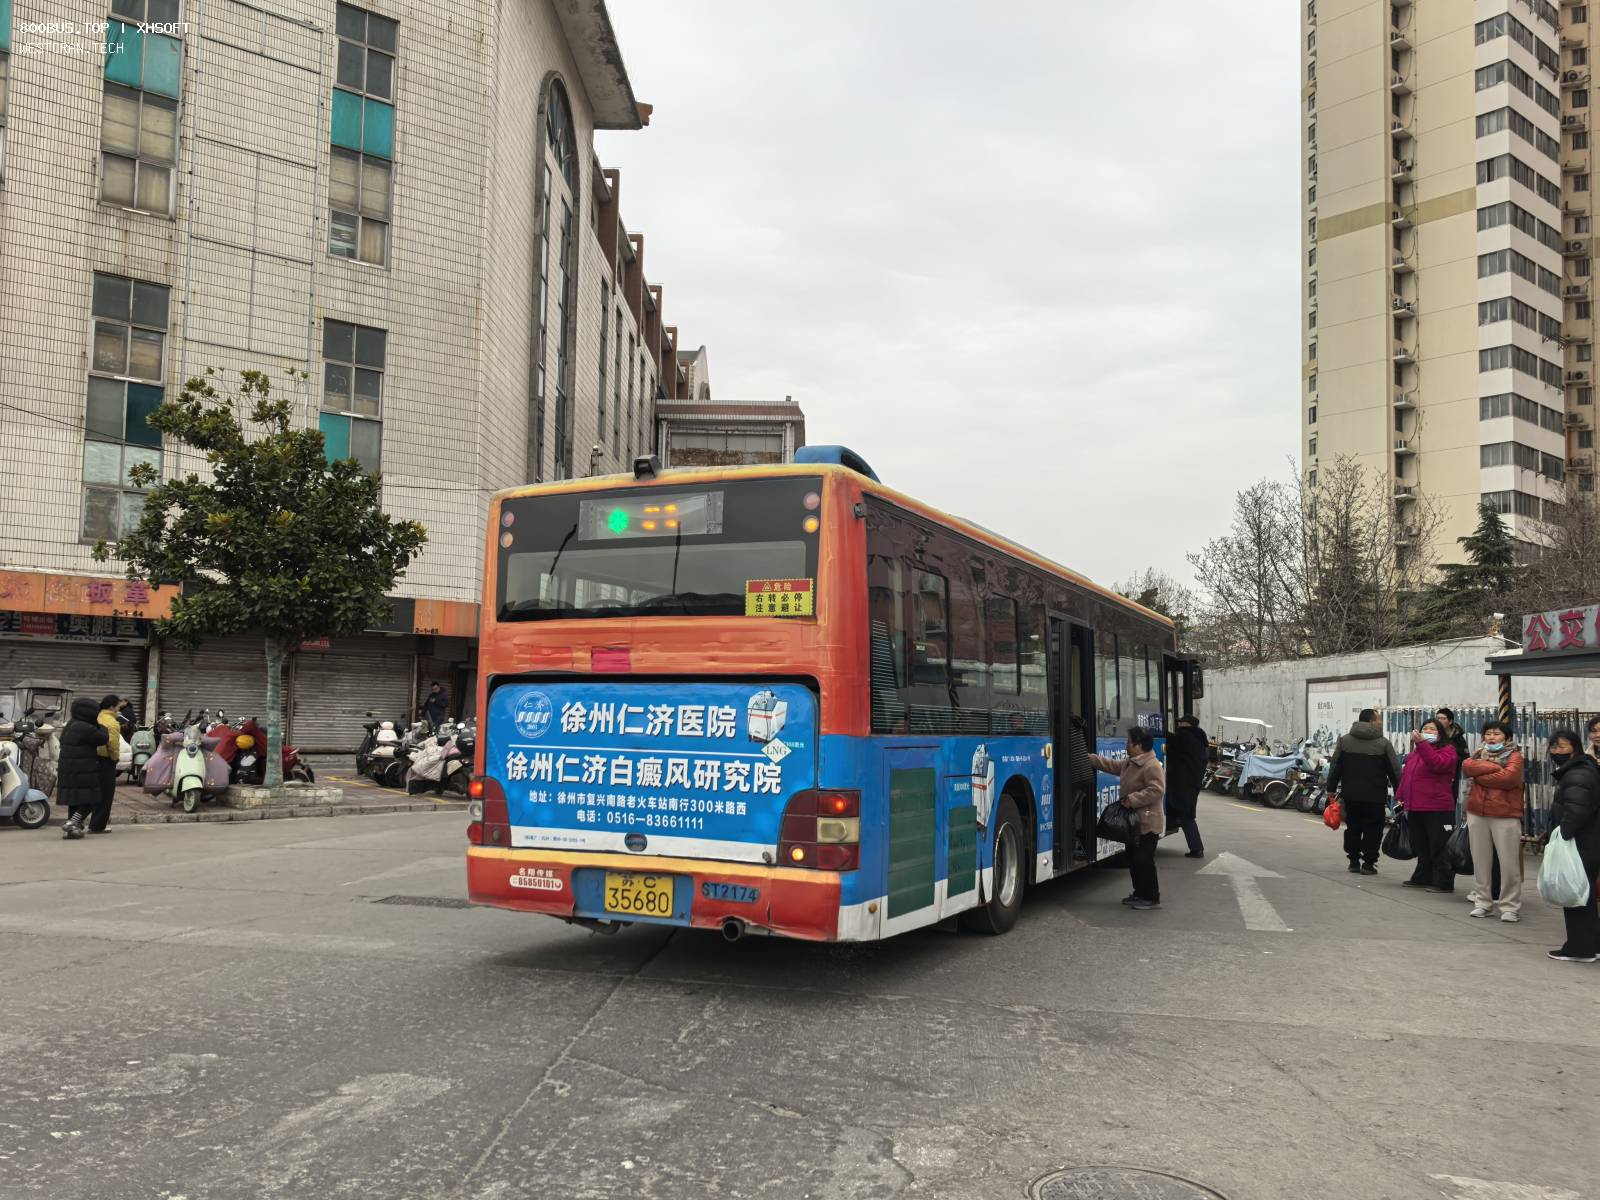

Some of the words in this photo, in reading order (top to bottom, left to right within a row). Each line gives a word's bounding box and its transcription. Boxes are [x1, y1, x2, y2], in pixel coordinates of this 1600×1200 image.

[755, 592, 803, 603] 右转必停
[773, 582, 792, 592] 危险
[755, 602, 803, 613] 注意避让
[1525, 607, 1600, 652] 公交
[560, 701, 737, 738] 徐州仁济医院
[766, 745, 787, 756] LNG
[505, 751, 782, 795] 徐州仁济白癜风研究院
[607, 887, 670, 914] 35680
[701, 881, 757, 902] ST2174
